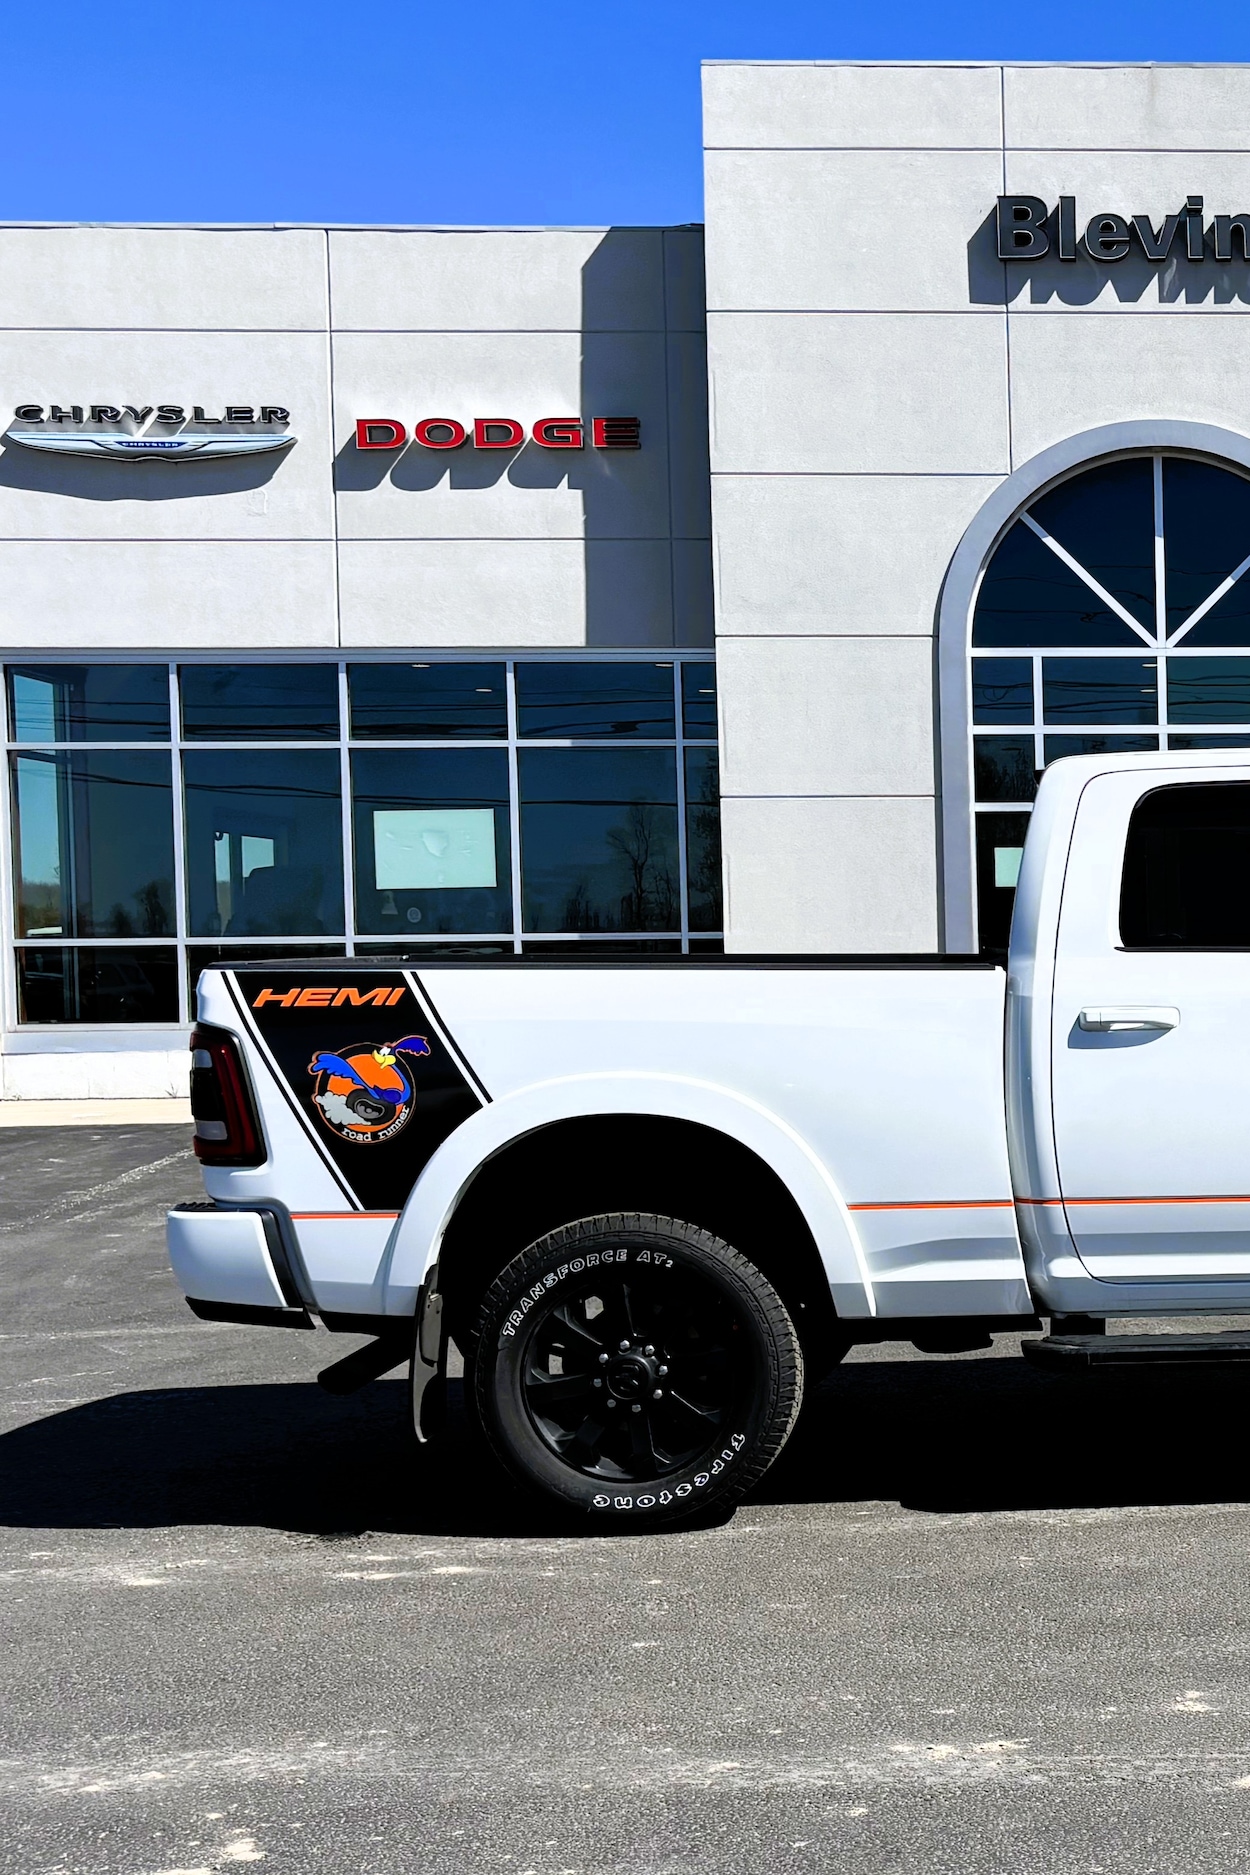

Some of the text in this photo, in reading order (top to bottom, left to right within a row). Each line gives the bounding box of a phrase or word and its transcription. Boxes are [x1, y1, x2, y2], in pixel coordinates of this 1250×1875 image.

[14, 404, 290, 424] CHRYSLER
[355, 417, 640, 450] DODGE
[252, 987, 406, 1007] HEMI
[341, 1105, 410, 1141] road runner
[501, 1249, 628, 1338] TRANSFORCE
